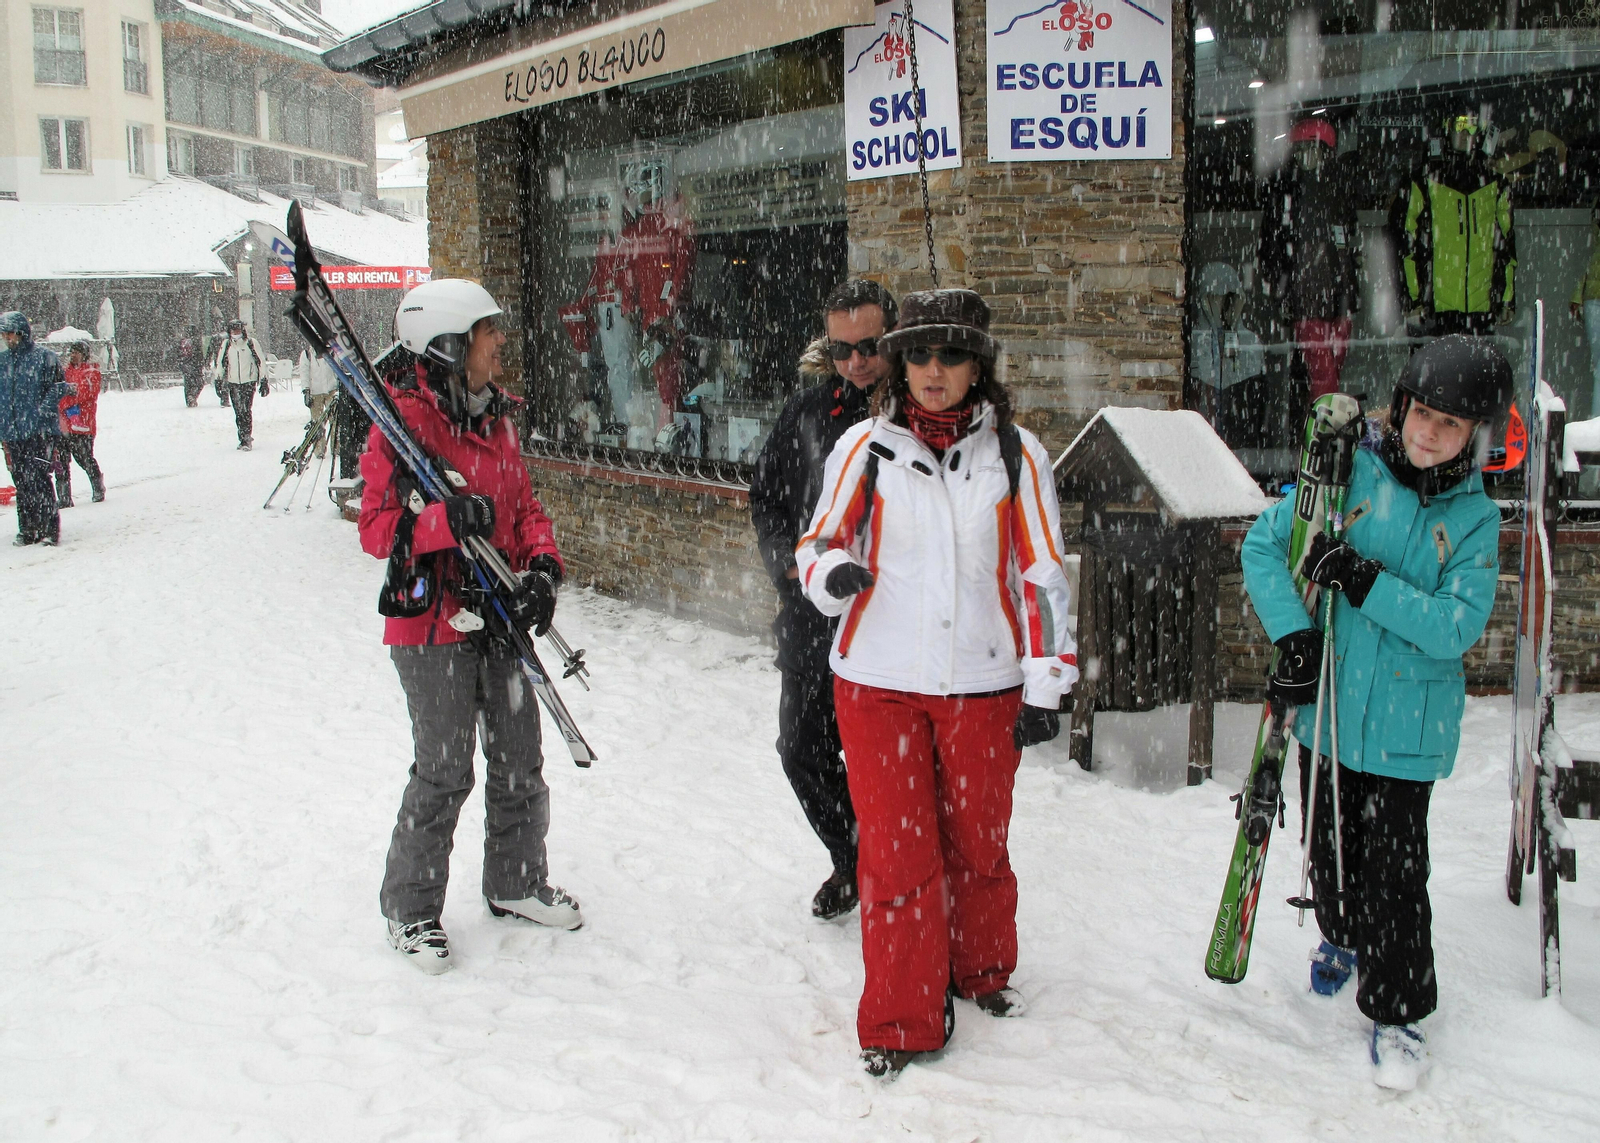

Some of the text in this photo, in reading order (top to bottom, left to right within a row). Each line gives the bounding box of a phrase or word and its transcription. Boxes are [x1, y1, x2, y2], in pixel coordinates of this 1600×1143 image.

[1042, 12, 1113, 31] EL OSO
[578, 27, 666, 84] BLANCO
[874, 53, 884, 63] EL
[996, 61, 1163, 91] ESCUELA
[868, 88, 927, 127] SKI
[1060, 93, 1097, 114] DE
[1010, 108, 1148, 152] ESQUÍ
[852, 127, 957, 171] SCHOOL
[347, 272, 363, 284] SKI
[364, 272, 400, 284] RENTAL
[1210, 903, 1232, 972] FORMULA
